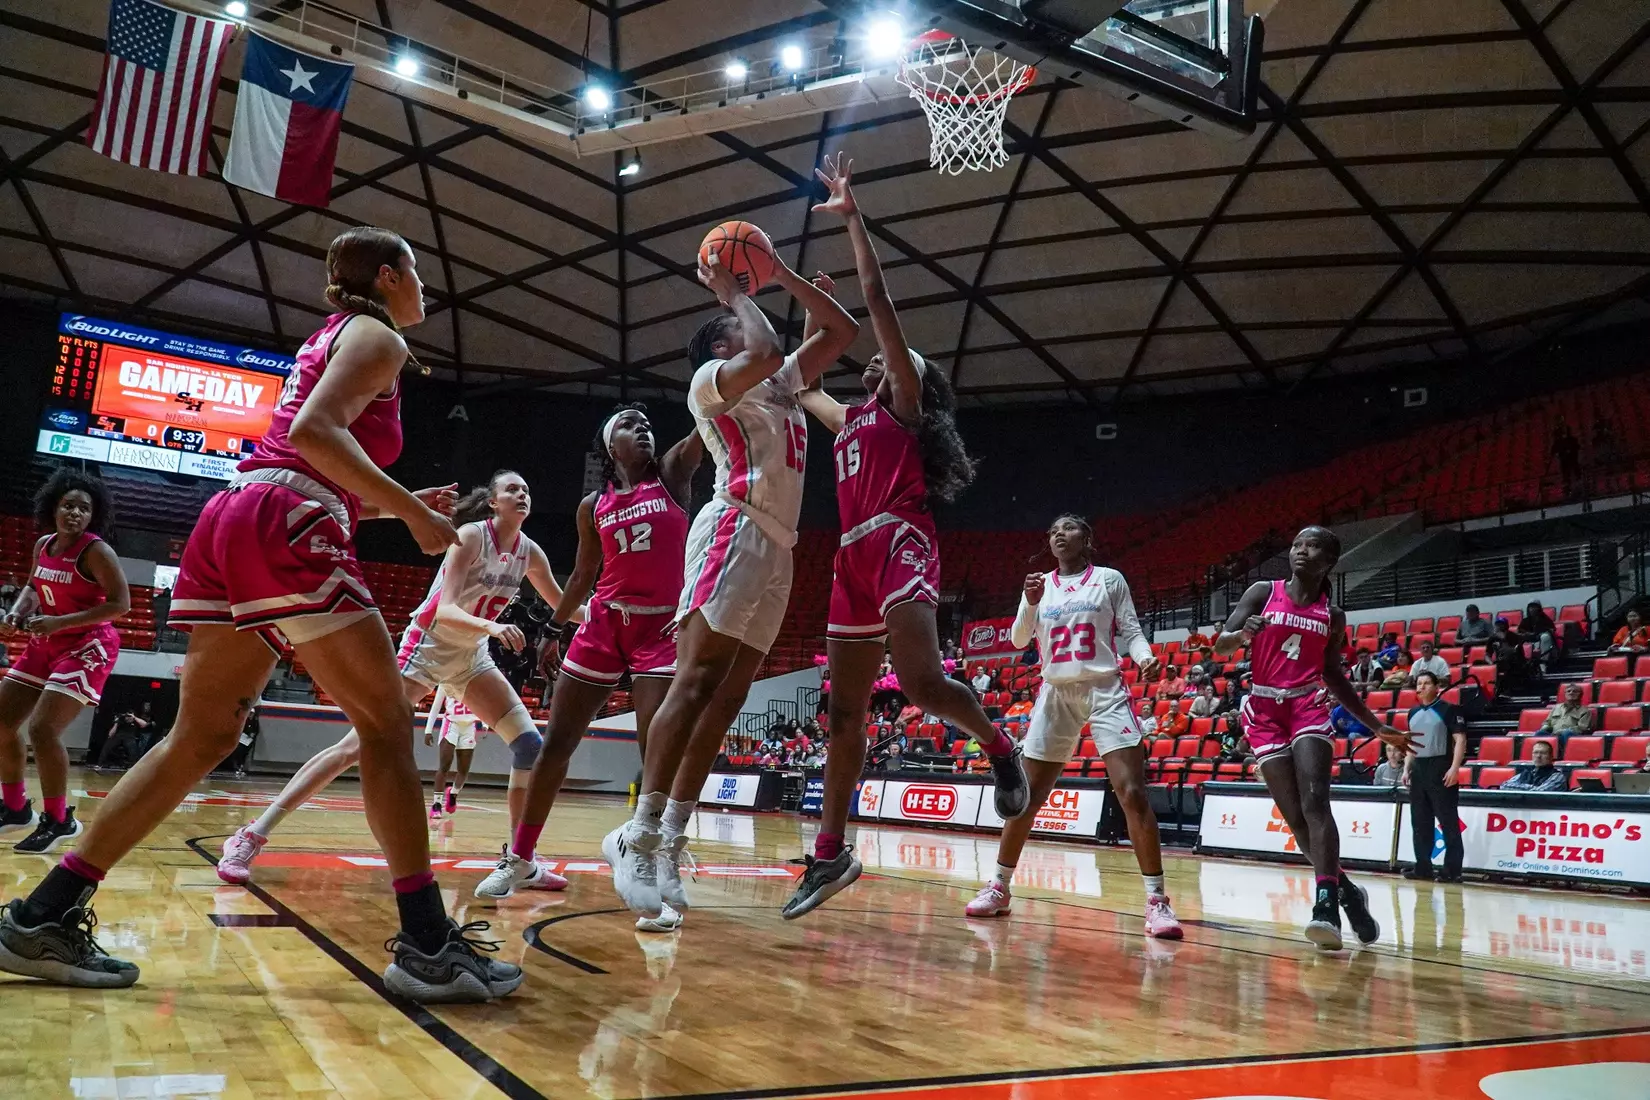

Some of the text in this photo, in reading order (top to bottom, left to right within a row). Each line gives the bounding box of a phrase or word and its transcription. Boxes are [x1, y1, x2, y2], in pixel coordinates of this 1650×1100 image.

[73, 321, 159, 344] BUD LIGHT
[59, 335, 72, 344] PLY
[84, 340, 98, 349] PTS
[164, 344, 185, 352] DRINK
[62, 345, 70, 354] 0
[76, 347, 84, 357] 0
[74, 358, 82, 367] 0
[243, 354, 277, 367] BUD
[56, 365, 66, 374] 12
[72, 368, 80, 377] 0
[146, 358, 163, 367] SAM
[165, 361, 201, 375] HOUSTON
[222, 372, 242, 381] TECH
[119, 360, 264, 408] GAMEDAY
[1404, 388, 1427, 407] D
[448, 405, 469, 421] A
[147, 425, 157, 437] 0
[173, 430, 204, 444] 9:37
[1096, 423, 1117, 439] C
[228, 438, 237, 450] 0
[112, 455, 174, 470] HERMANN
[114, 446, 176, 463] MEMORIAL
[202, 458, 227, 467] FIRST
[836, 438, 860, 483] 15
[191, 462, 236, 474] FINANCIAL
[201, 469, 225, 478] BANK
[618, 498, 667, 521] HOUSTON
[613, 522, 652, 554] 12
[41, 584, 56, 607] 0
[1285, 611, 1329, 637] HOUSTON
[1050, 623, 1095, 663] 23
[1281, 633, 1302, 660] 4
[722, 778, 737, 788] BUD
[717, 789, 738, 800] LIGHT
[1043, 790, 1079, 809] CH
[1030, 820, 1067, 831] 5.9966
[1486, 813, 1641, 841] Domino's
[1515, 838, 1604, 864] Pizza
[1497, 860, 1521, 869] Order
[1524, 861, 1550, 872] Online
[1562, 865, 1623, 877] Dominos.com
